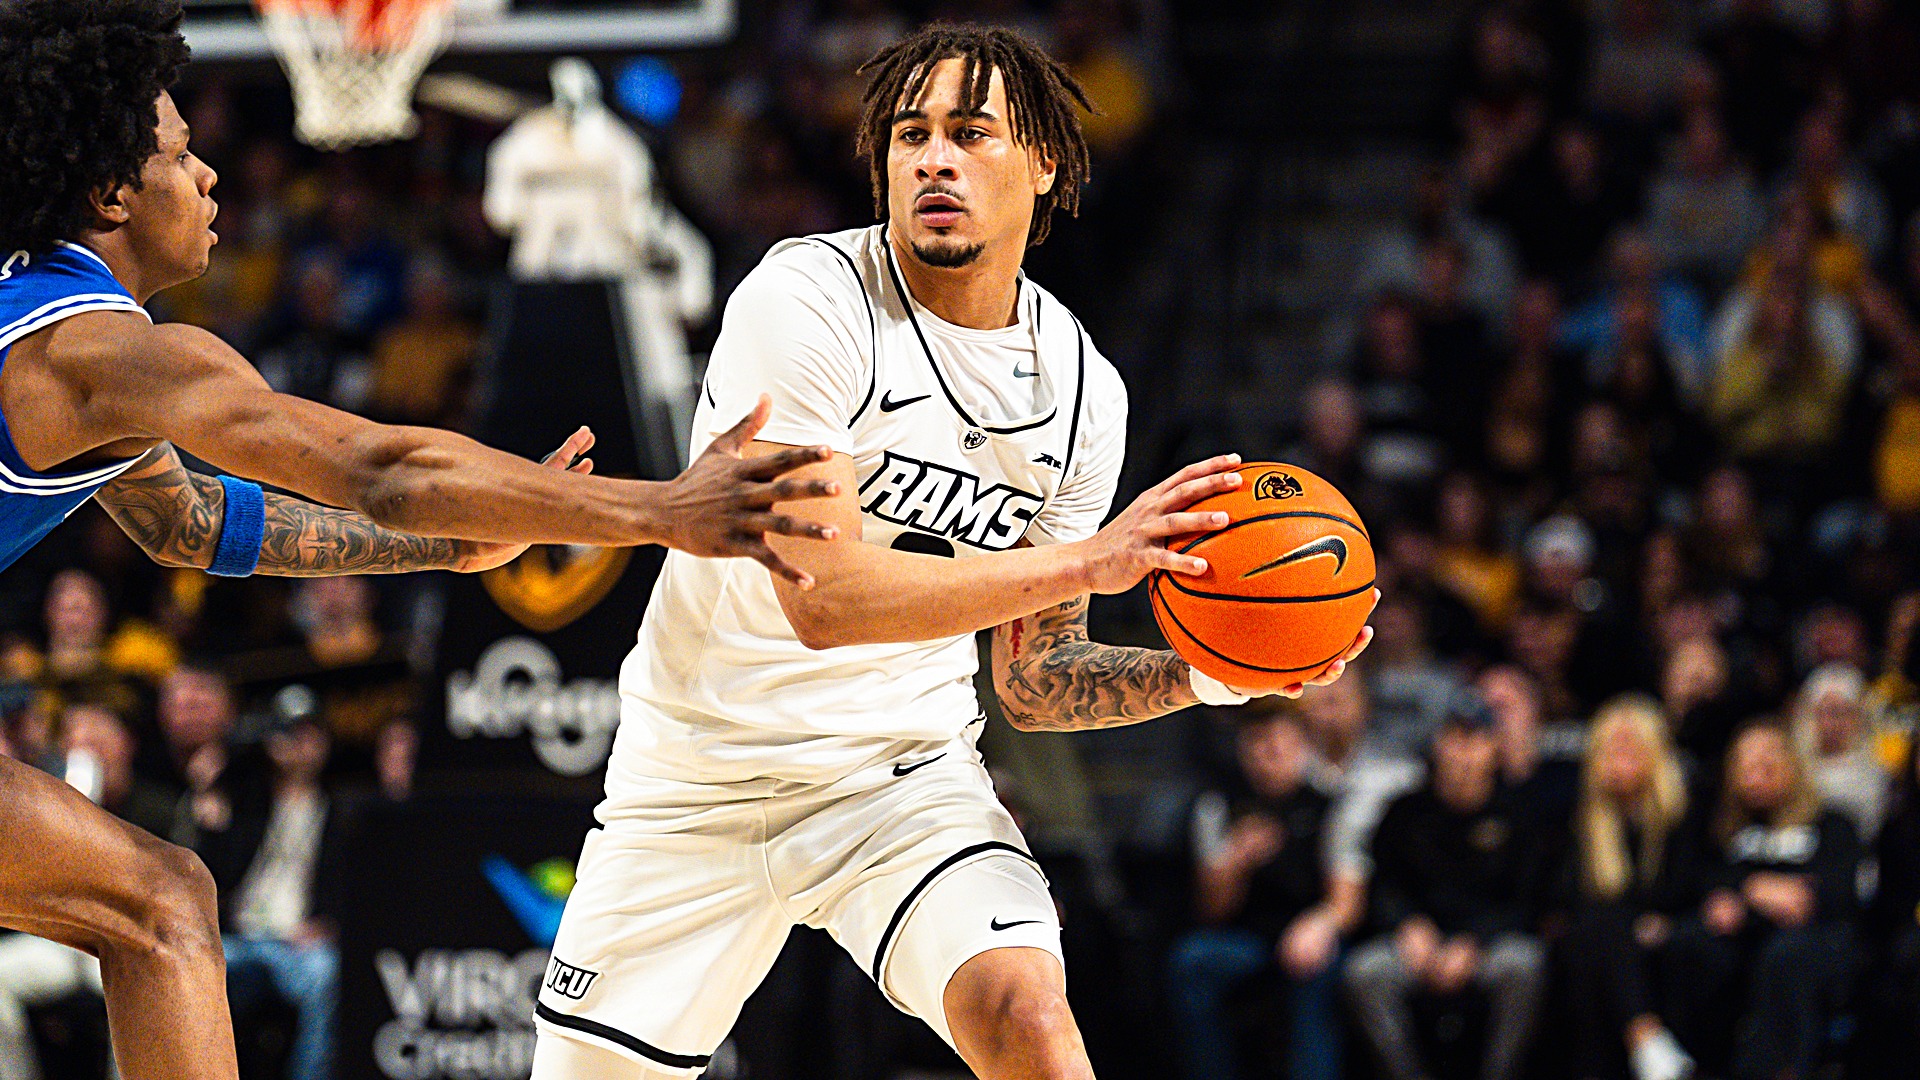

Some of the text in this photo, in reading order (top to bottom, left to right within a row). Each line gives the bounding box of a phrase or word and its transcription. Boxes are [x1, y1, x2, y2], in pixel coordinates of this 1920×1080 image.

[858, 450, 1046, 552] RAMS
[446, 635, 622, 778] Kroge
[547, 956, 599, 1001] VCU
